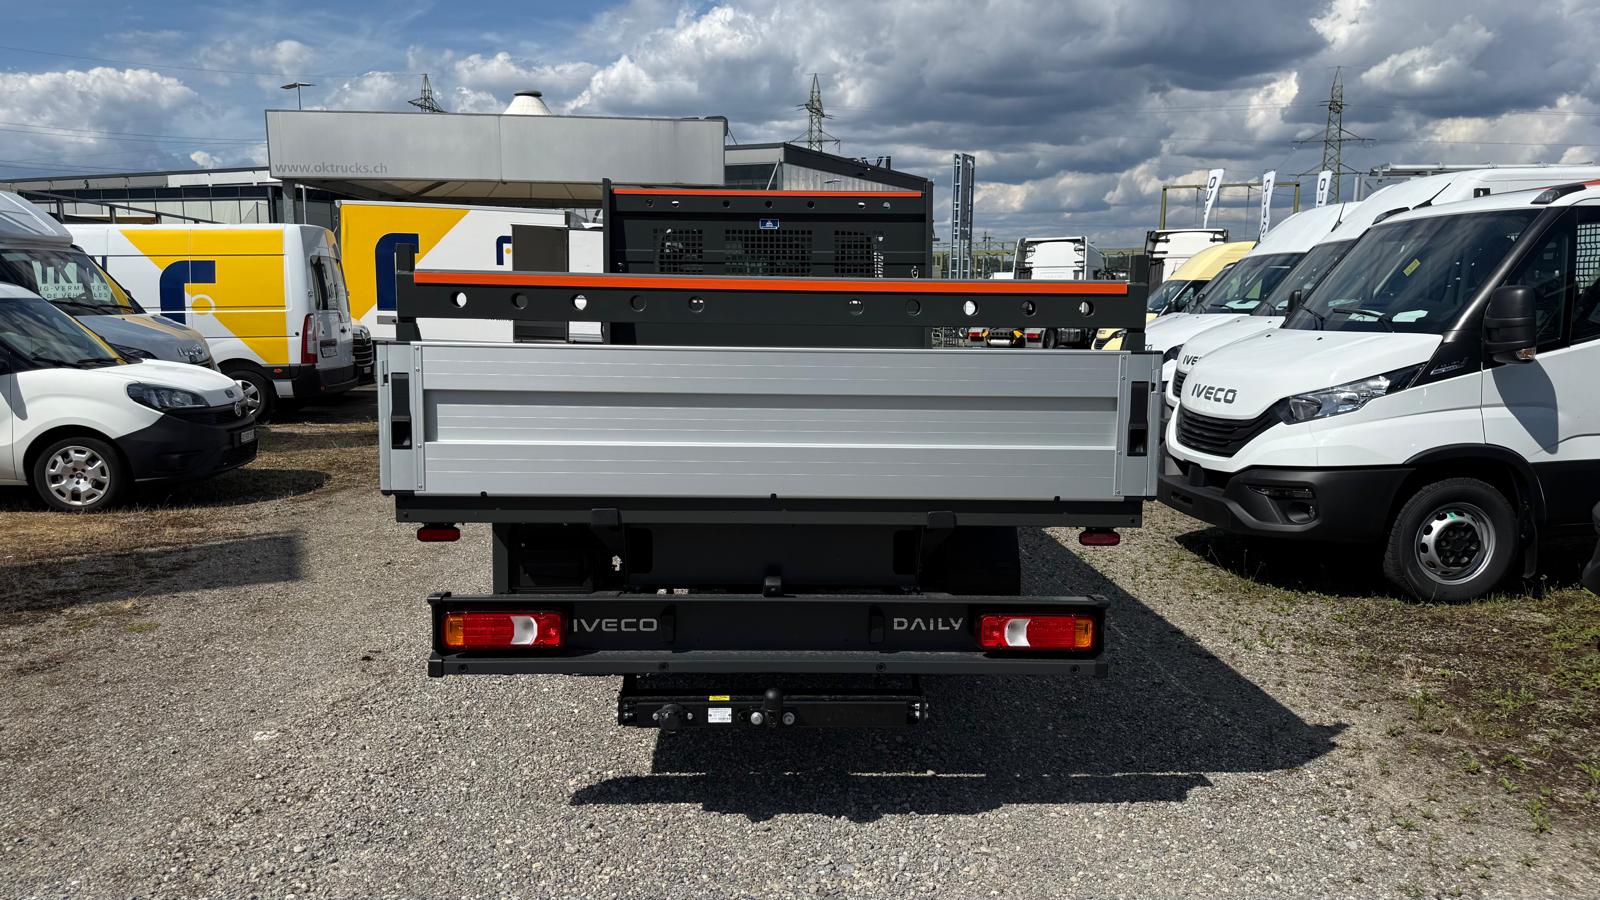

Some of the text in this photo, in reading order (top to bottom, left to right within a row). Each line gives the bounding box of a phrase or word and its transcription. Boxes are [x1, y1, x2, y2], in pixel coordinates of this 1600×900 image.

[275, 161, 388, 174] www.oktrucks.ch
[1182, 355, 1202, 365] IVE
[1191, 383, 1237, 404] IVECO
[574, 618, 657, 632] IVECO
[893, 617, 964, 631] DAILY
